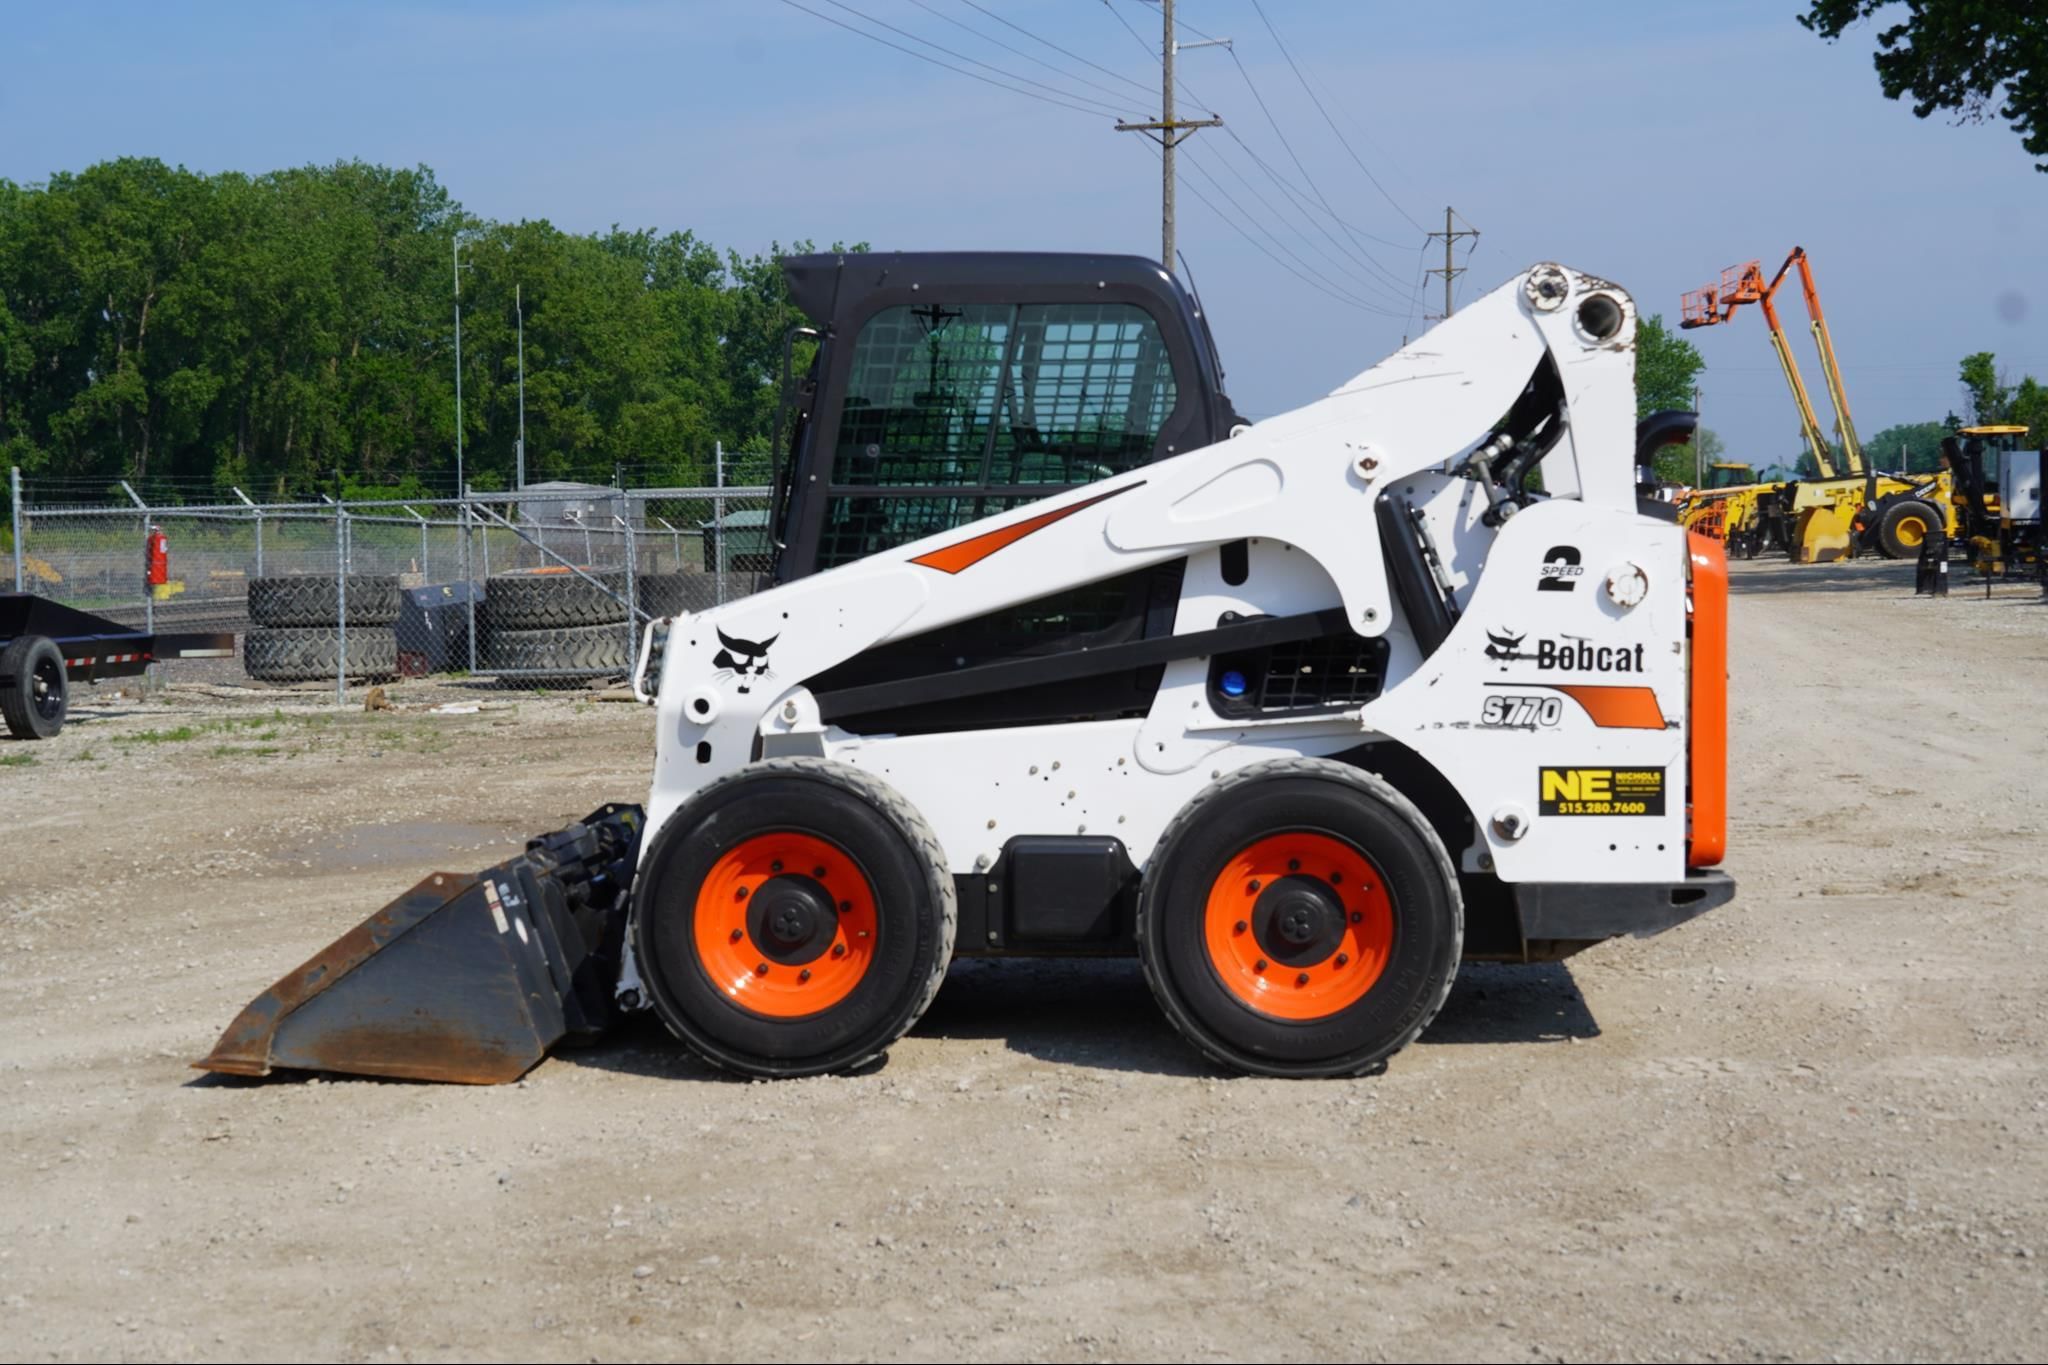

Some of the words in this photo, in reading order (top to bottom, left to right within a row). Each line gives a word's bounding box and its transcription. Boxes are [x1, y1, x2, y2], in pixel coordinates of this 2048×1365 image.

[1537, 545, 1581, 592] 2
[1541, 566, 1584, 576] SPEED
[1537, 639, 1644, 673] Bobcat
[1481, 695, 1563, 727] S770
[1542, 770, 1613, 801] NE
[1558, 802, 1646, 814] 515.280.7600
